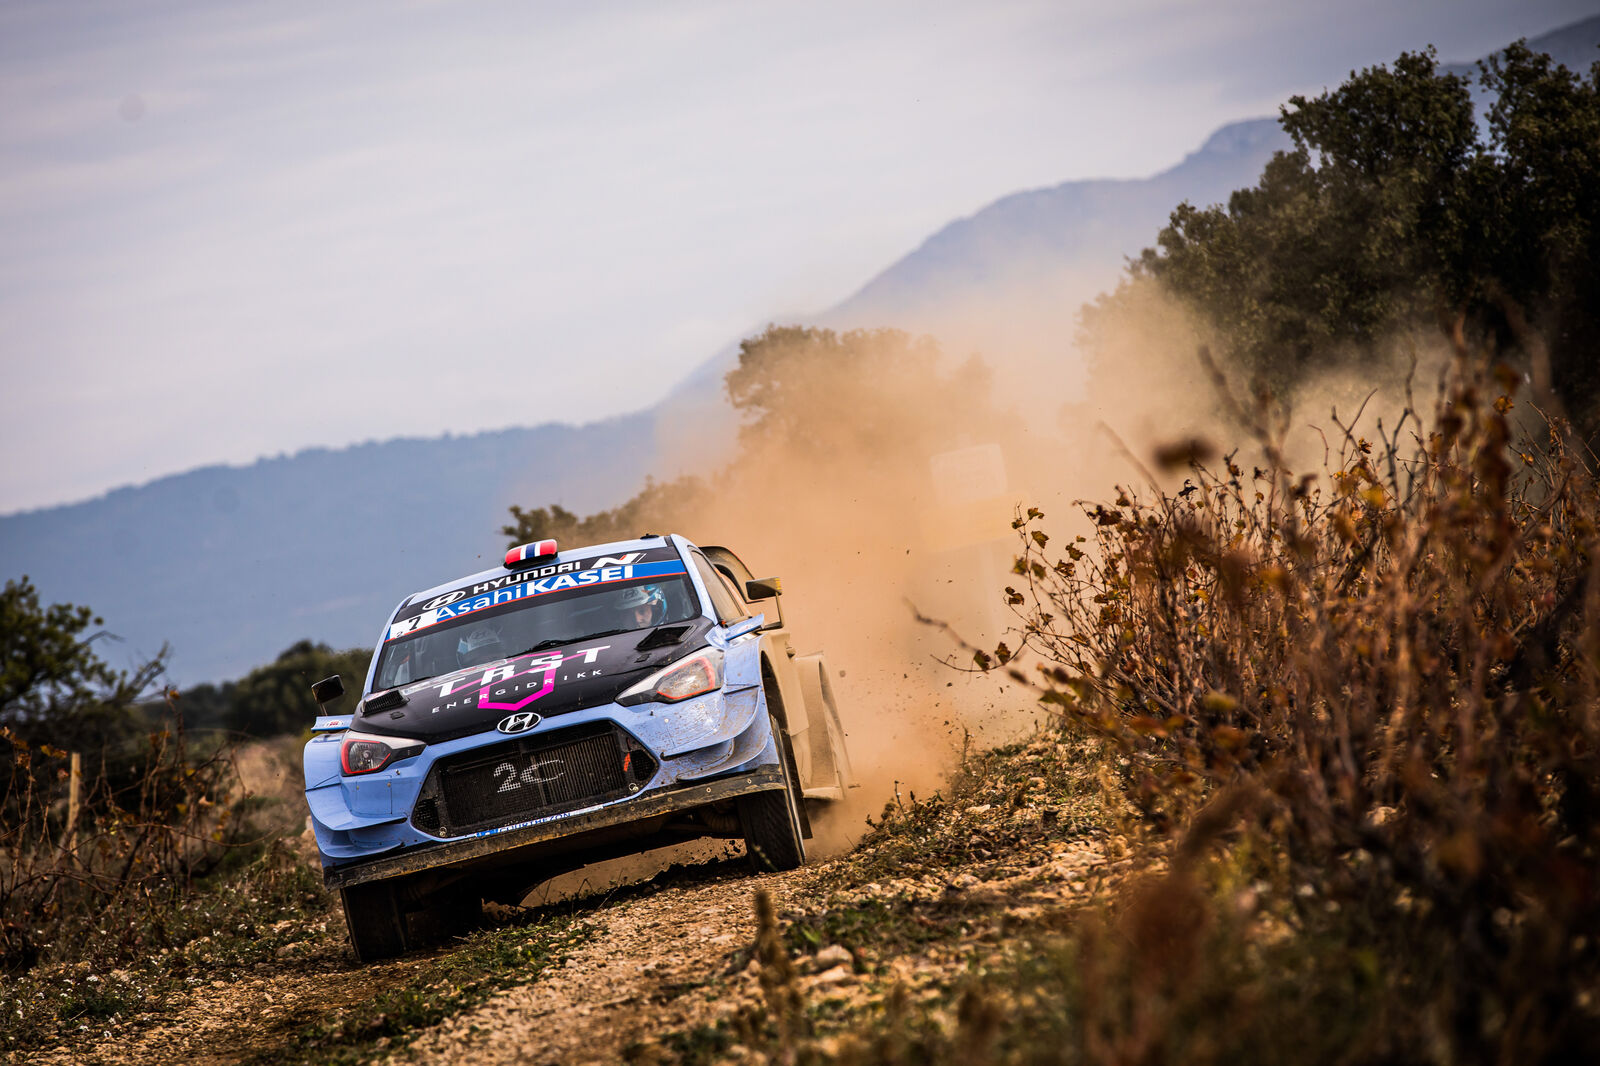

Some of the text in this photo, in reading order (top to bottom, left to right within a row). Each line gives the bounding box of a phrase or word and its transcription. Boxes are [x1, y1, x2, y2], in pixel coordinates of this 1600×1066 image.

[473, 561, 581, 595] HYUNDAI
[408, 616, 422, 631] 7
[433, 645, 611, 698] TRST
[431, 669, 602, 714] ENERGIDRIKK
